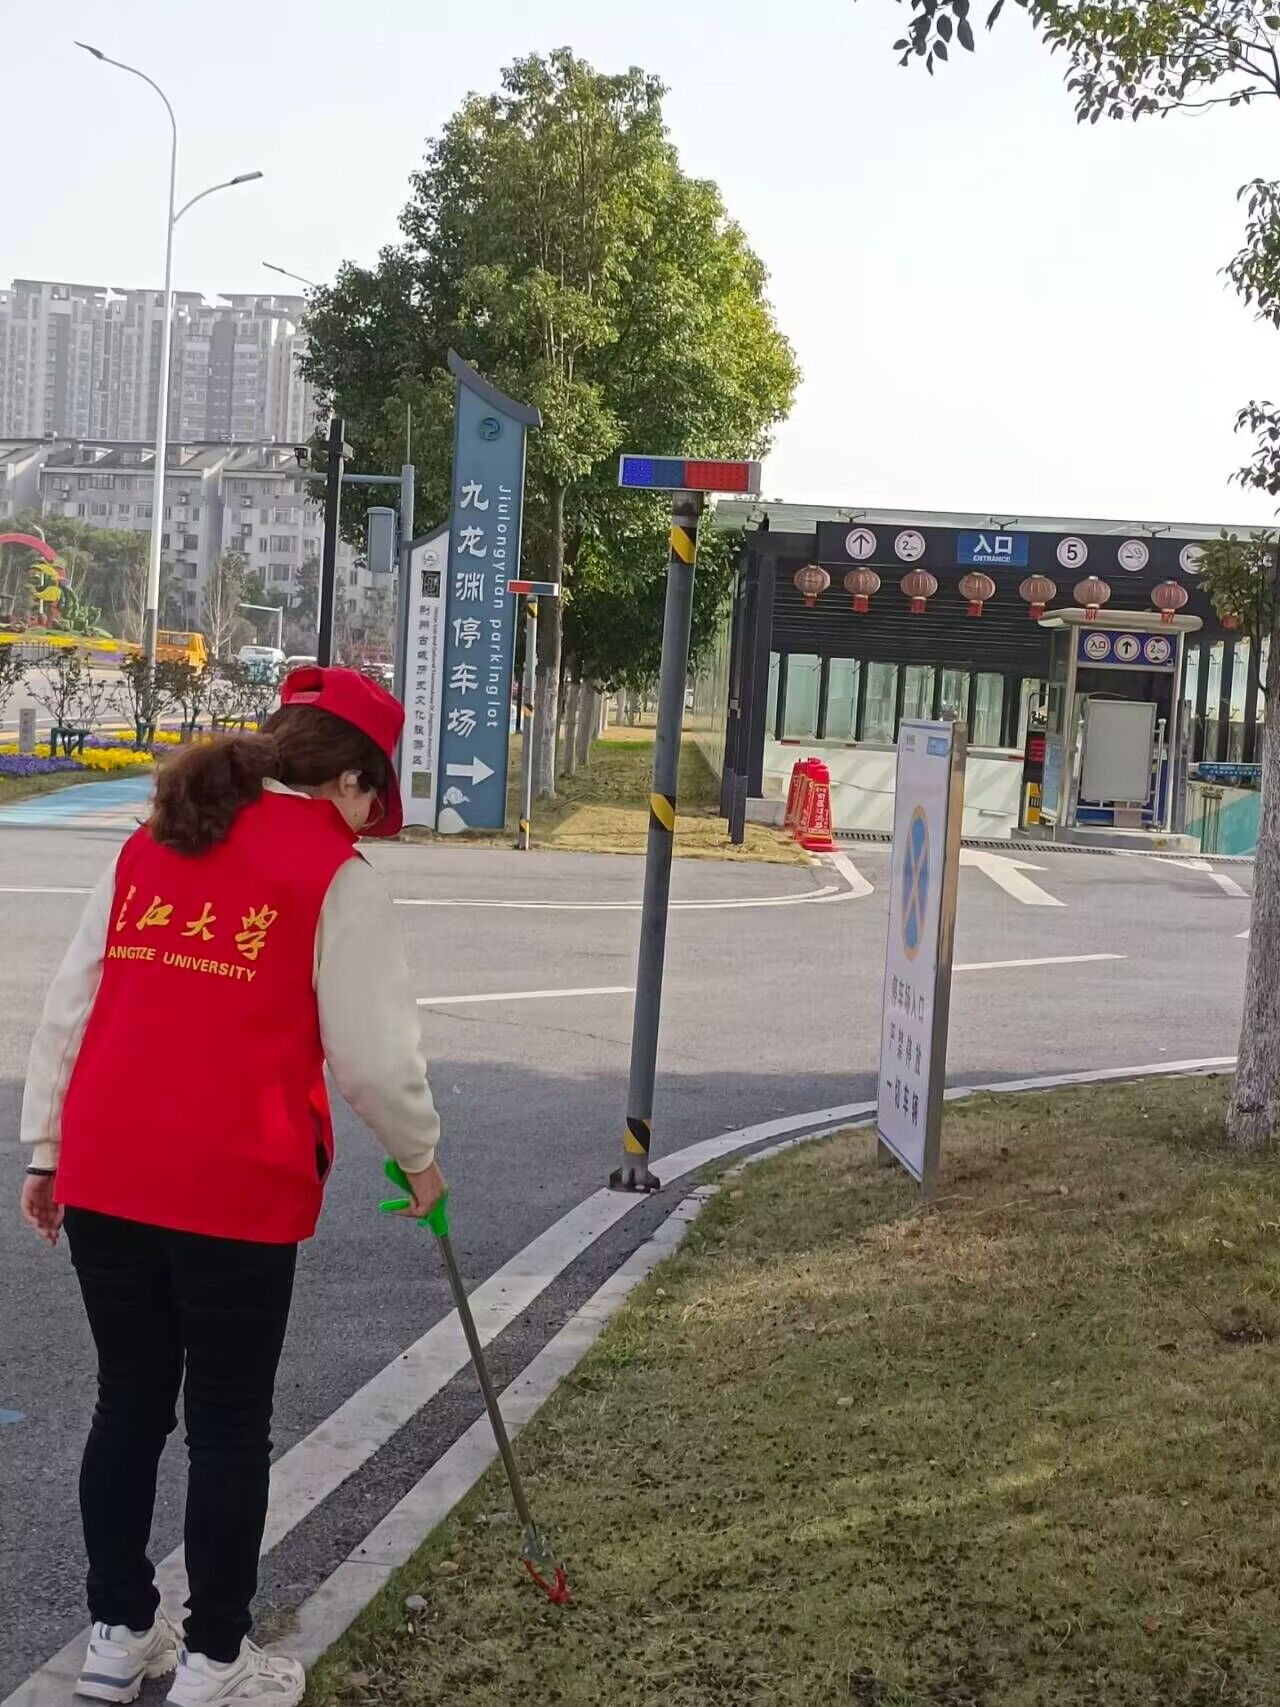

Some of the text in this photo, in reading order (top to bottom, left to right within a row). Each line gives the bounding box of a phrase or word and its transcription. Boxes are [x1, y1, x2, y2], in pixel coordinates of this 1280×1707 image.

[492, 484, 511, 609] Jiulongyuan
[973, 534, 1013, 554] 入口
[1067, 544, 1078, 560] 5
[447, 479, 489, 738] 九龙渊停车场
[1090, 640, 1106, 650] 入口
[106, 945, 257, 982] ANGTZE UNIVERSITY
[886, 1077, 919, 1128] 一切车辆
